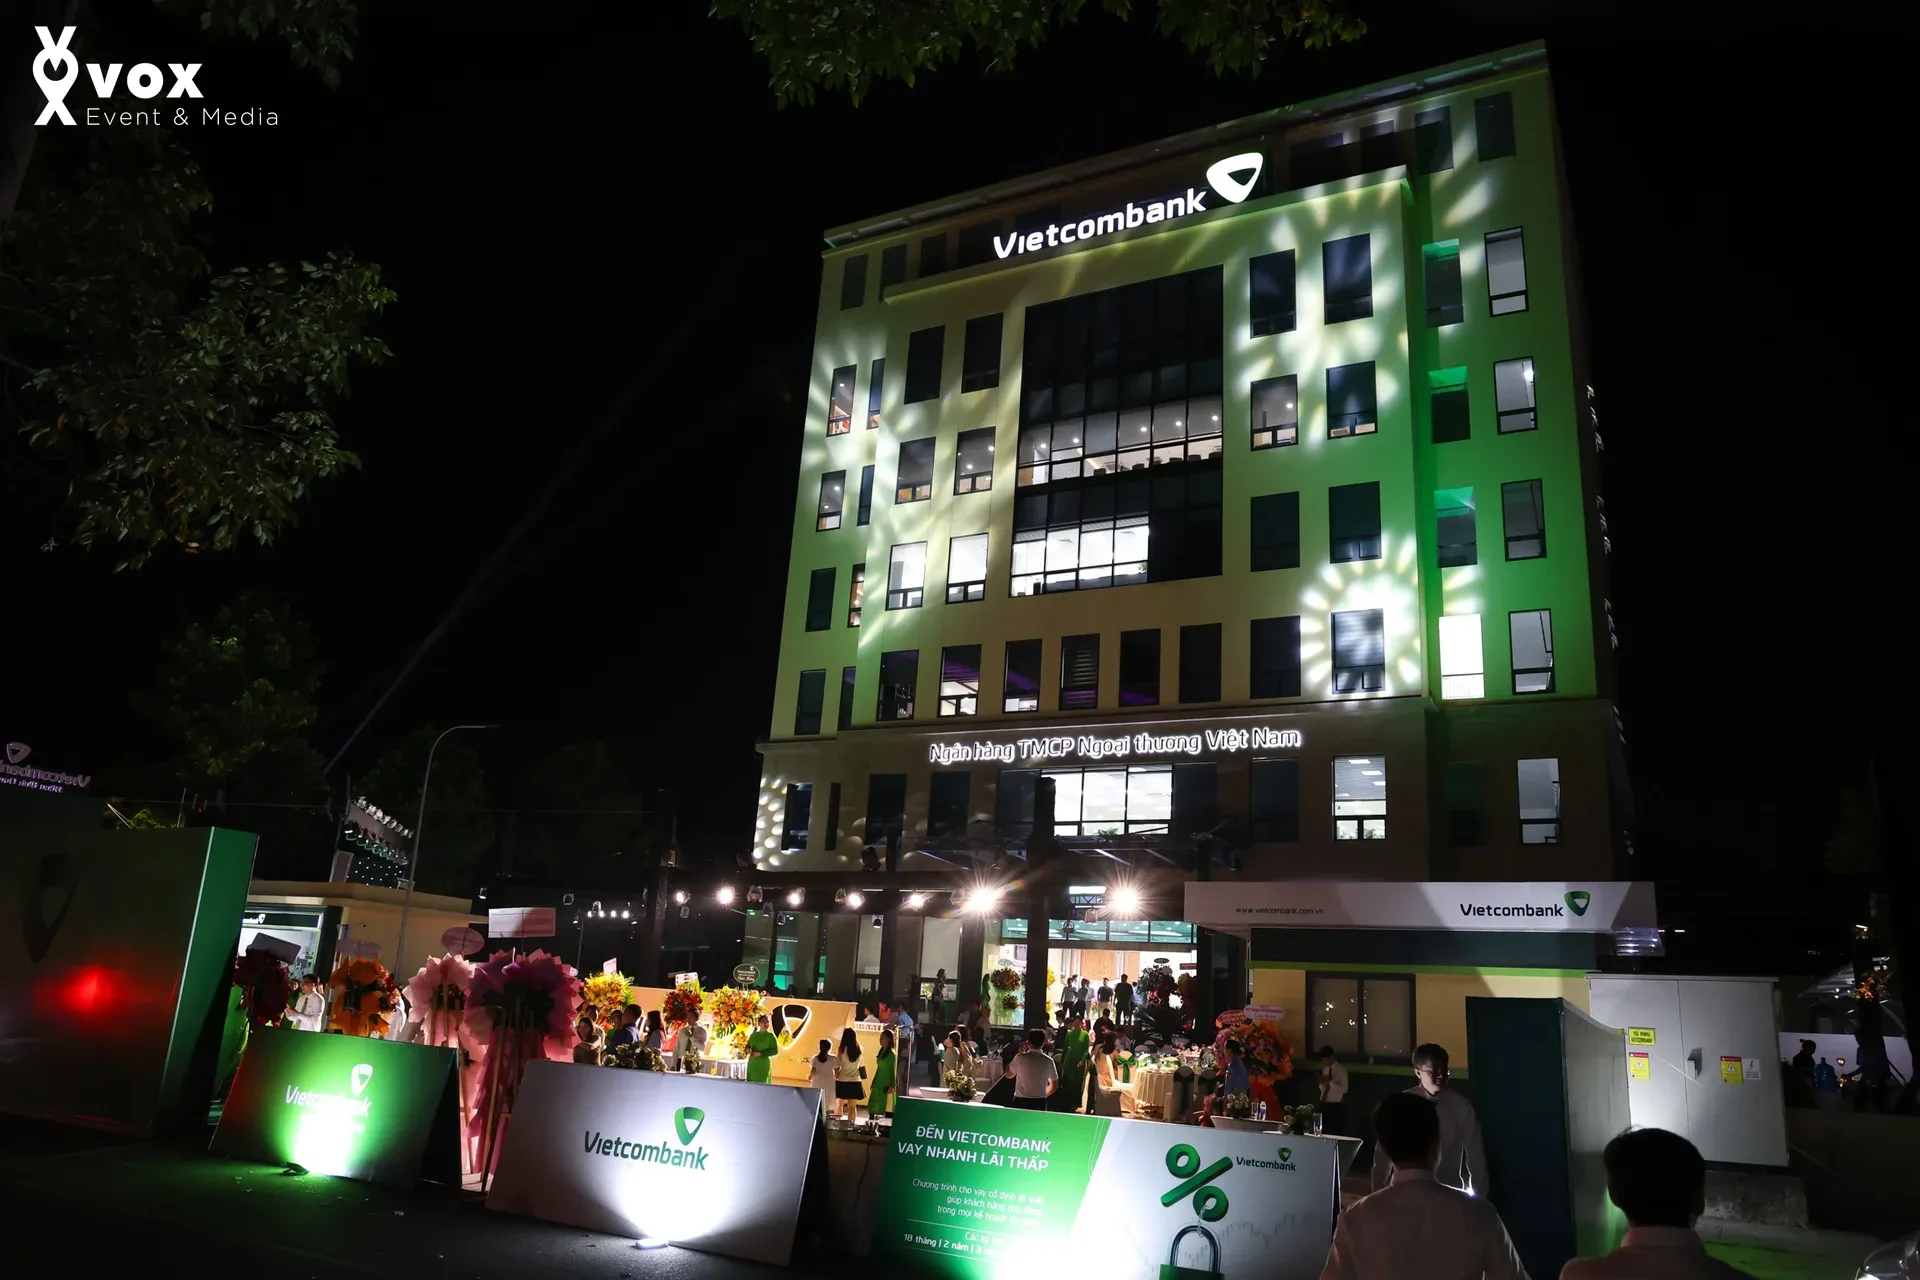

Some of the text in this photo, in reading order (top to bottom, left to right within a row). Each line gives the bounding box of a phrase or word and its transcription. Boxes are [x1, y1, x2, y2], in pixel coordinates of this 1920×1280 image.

[993, 188, 1207, 259] Vietcombank
[930, 742, 972, 765] Ngân
[973, 741, 1015, 763] hàng
[1017, 737, 1075, 759] TMCP
[1078, 735, 1130, 759] Ngoại
[1205, 728, 1249, 752] Việt
[1252, 726, 1302, 748] Nam
[1460, 903, 1564, 917] Vietcombank
[916, 1124, 1052, 1154] ĐẾN VIETCOMBANK
[584, 1130, 709, 1171] Vietcombank
[898, 1142, 1049, 1172] VAY NHANH LÃI THẤP
[1236, 1156, 1296, 1171] Vietcombank
[958, 1185, 972, 1195] cho
[974, 1189, 987, 1198] vay
[937, 1204, 956, 1216] trong
[963, 1196, 985, 1208] khách
[903, 1233, 913, 1242] 18
[915, 1235, 937, 1248] tháng
[943, 1239, 949, 1249] 2
